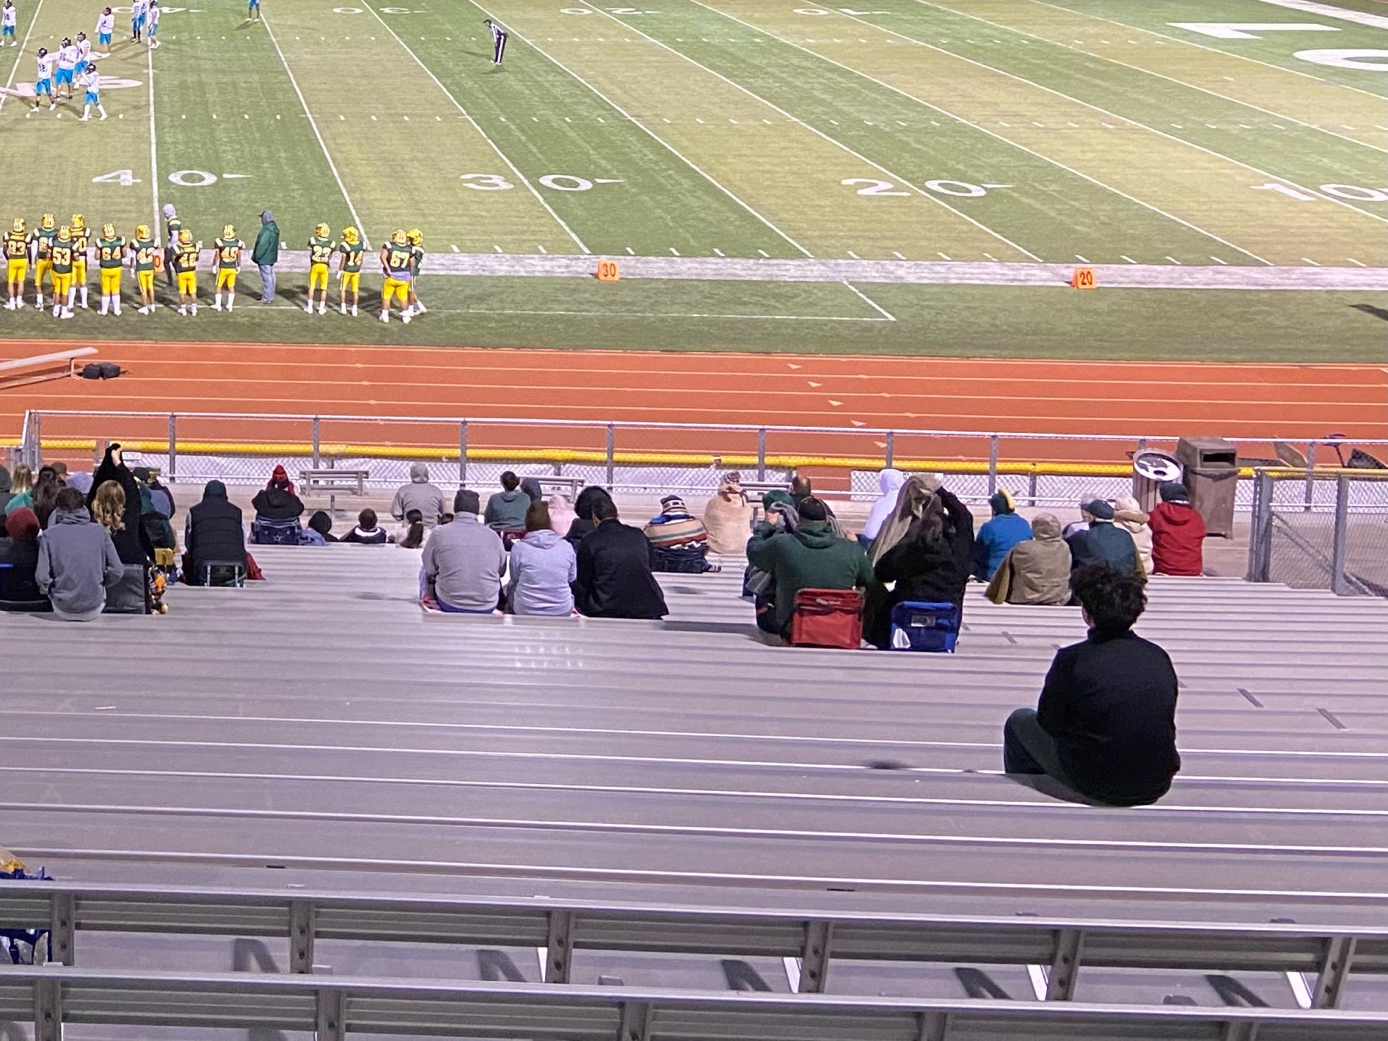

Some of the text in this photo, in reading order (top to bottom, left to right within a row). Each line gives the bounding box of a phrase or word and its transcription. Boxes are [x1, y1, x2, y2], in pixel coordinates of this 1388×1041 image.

[52, 247, 71, 266] 53
[602, 262, 616, 278] 30
[1079, 271, 1093, 286] 20
